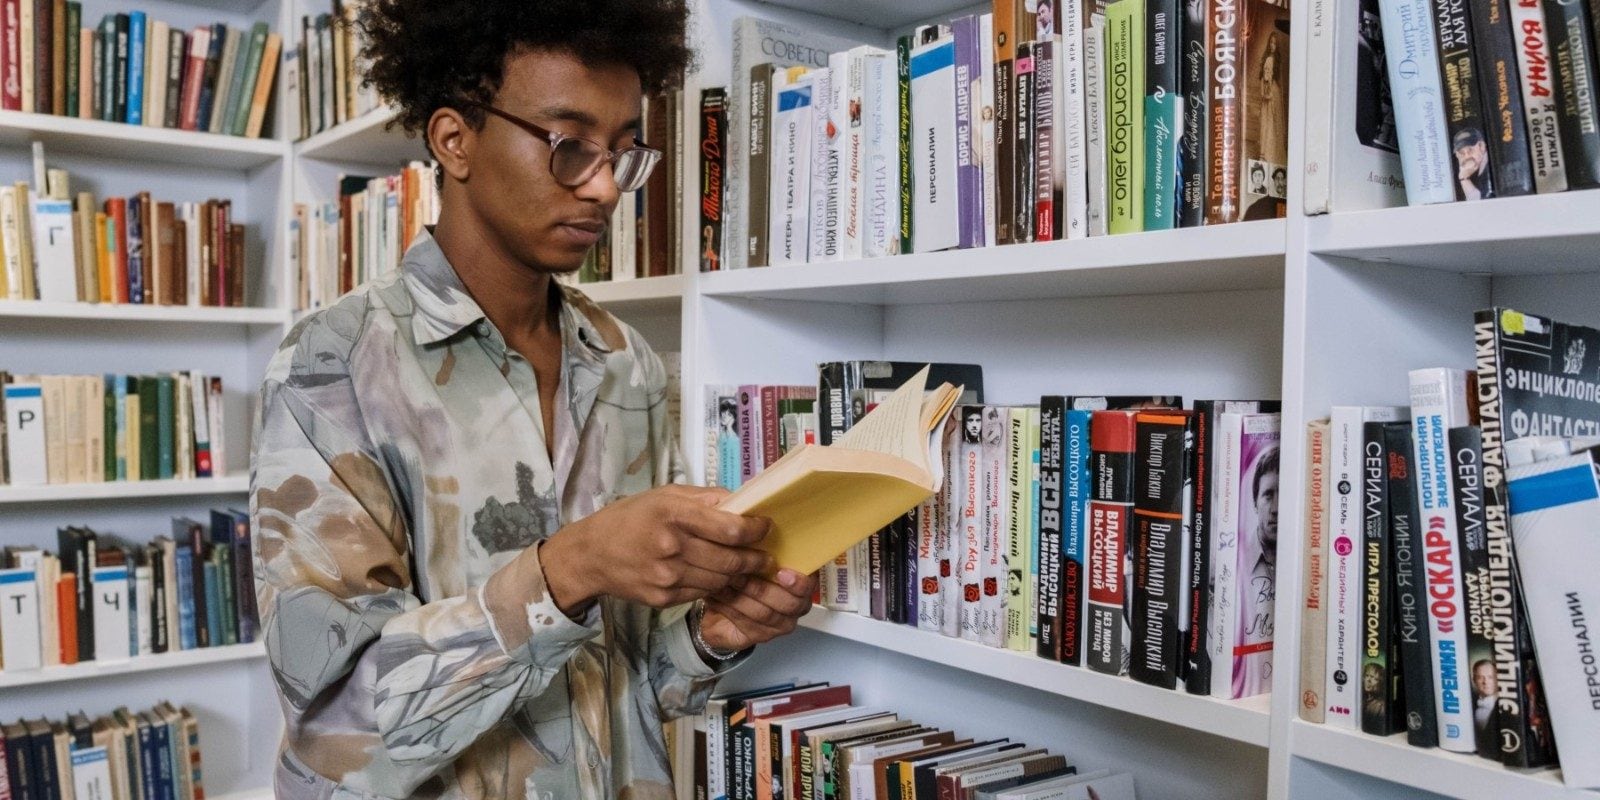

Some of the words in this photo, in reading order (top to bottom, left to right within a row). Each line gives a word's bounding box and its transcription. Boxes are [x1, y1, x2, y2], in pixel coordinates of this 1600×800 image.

[1119, 20, 1127, 60] ИЗМЕРЕНИЕ
[1155, 13, 1166, 31] ОЛЕГ
[1397, 4, 1420, 80] Дмитрий
[1453, 17, 1468, 44] ДЛЯ
[733, 27, 741, 81] CINEMA
[1087, 36, 1098, 98] БАТАЛОВ
[1155, 33, 1165, 65] БОРИСОВ
[1186, 40, 1204, 82] Сергей
[1522, 19, 1552, 97] ВОЙНА
[957, 65, 968, 121] АНДРЕЕВ
[1019, 75, 1027, 117] АРТМАНЕ
[1037, 92, 1052, 127] БАСОВ
[1110, 62, 1132, 154] борисов
[1543, 104, 1554, 113] Я
[702, 117, 720, 158] Дона
[958, 125, 969, 166] БОРИС
[1019, 120, 1027, 139] ВИЯ
[1089, 100, 1099, 146] Алексей
[1184, 91, 1204, 159] Бондарчук
[1545, 117, 1560, 168] служил
[732, 141, 740, 179] КИНО
[789, 156, 794, 166] И
[827, 150, 837, 186] АКТЕРЫ
[850, 133, 860, 181] троица
[1039, 132, 1051, 199] ВЛАДИМИР
[1154, 116, 1170, 189] Абсолютный
[1212, 106, 1223, 199] Театральная
[1532, 118, 1547, 177] десанте
[702, 163, 720, 221] Тихого
[1115, 160, 1127, 200] олег
[1192, 173, 1200, 186] ЕГО
[1192, 187, 1200, 209] ВОЙНА
[826, 189, 836, 226] НАШЕГО
[1155, 193, 1163, 218] ноль
[50, 226, 63, 245] Г
[826, 229, 835, 256] КИНО
[20, 410, 35, 430] Р
[764, 391, 772, 416] ВЕРА
[830, 389, 845, 426] правил
[1042, 409, 1052, 443] ТАК,
[1475, 321, 1504, 487] ФАНТАСТИКИ
[742, 409, 751, 476] ВАСИЛЬЕВА
[765, 419, 774, 466] ВАСИЛЬ
[1010, 418, 1021, 487] Владимир
[1043, 448, 1050, 468] НЕ
[1051, 407, 1060, 468] РЕБЯТА...
[1069, 424, 1080, 498] ВЫСОЦКОГО
[1149, 432, 1167, 467] Виктор
[1311, 430, 1324, 465] кино
[1431, 414, 1448, 508] ЭНЦИКЛОПЕДИЯ
[965, 451, 976, 518] Высоцкого
[1105, 467, 1113, 499] ЛУЧШИЕ
[1148, 469, 1164, 499] Бакин
[1365, 442, 1382, 520] СЕРИАЛ
[1417, 415, 1433, 509] ПОПУЛЯРНАЯ
[1309, 467, 1323, 549] венгерского
[1457, 448, 1479, 531] СЕРИАЛ
[920, 505, 931, 559] Марина
[1010, 490, 1021, 557] Высоцкий
[1067, 500, 1080, 555] Владимира
[1194, 512, 1203, 549] вечера
[965, 525, 978, 572] Друзья
[1092, 509, 1105, 590] ВЫСОЦКИЙ
[1105, 511, 1119, 593] ВЛАДИМИР
[1145, 523, 1171, 597] Владимир
[1192, 550, 1202, 589] Четыре
[1367, 542, 1380, 575] ИГРА
[835, 568, 848, 604] Галина
[1040, 532, 1048, 615] ВЛАДИМИР
[1046, 533, 1059, 617] ВЫСОЦКИЙ
[1306, 552, 1323, 611] История
[1425, 516, 1456, 633] «ОСКАР»
[104, 593, 120, 611] Ч
[1065, 561, 1078, 657] САМОУБИЙСТВО
[1104, 611, 1112, 629] БЕЗ
[1191, 590, 1200, 623] Рязанов
[1366, 577, 1380, 658] ПРЕСТОЛОВ
[1465, 572, 1481, 634] ДАУНТОН
[1484, 504, 1519, 715] ЭНЦИКЛОПЕДИЯ
[1092, 619, 1102, 651] ЛЕГЕНД
[1102, 631, 1112, 663] МИФОВ
[1144, 600, 1169, 672] Высоцкий
[1191, 624, 1200, 653] Эльдар
[1564, 592, 1600, 712] ПЕРСОНАЛИИ
[1438, 640, 1459, 714] ПРЕМИЯ
[800, 746, 811, 773] МОЙ
